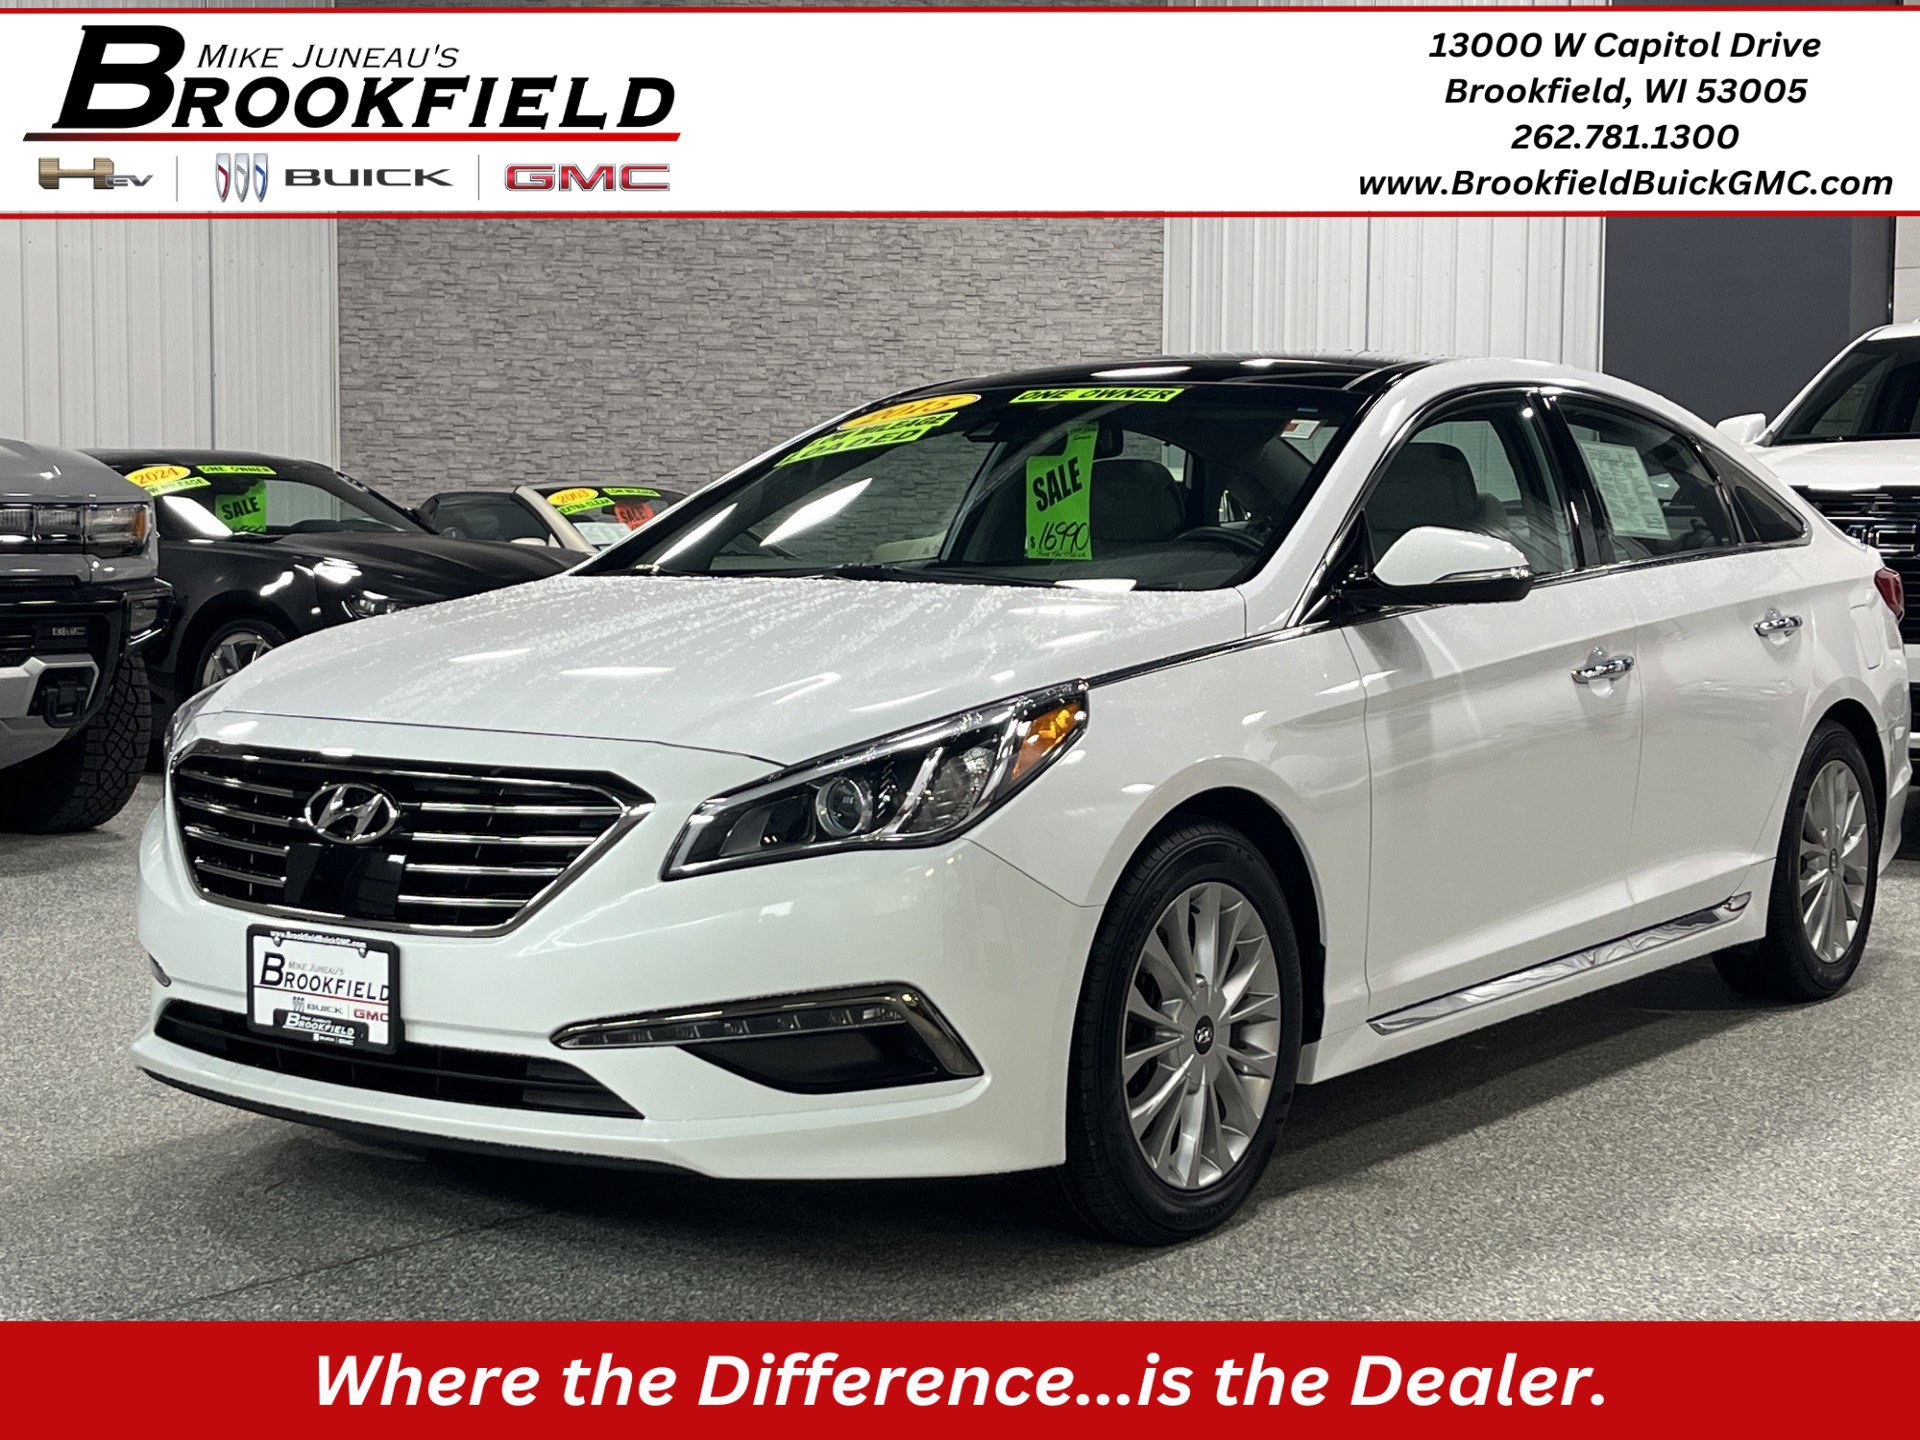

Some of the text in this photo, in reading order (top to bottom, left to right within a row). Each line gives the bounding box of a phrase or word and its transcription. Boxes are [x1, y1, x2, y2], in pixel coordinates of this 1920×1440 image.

[1018, 389, 1177, 401] ONE OWNER
[134, 467, 179, 485] 2024
[1032, 456, 1083, 512] SALE
[221, 497, 261, 520] SALE
[259, 951, 389, 1002] BROOKFIELD
[307, 1003, 343, 1015] BUICK
[353, 1008, 389, 1023] GMC
[285, 1012, 355, 1036] BROOKFIELD
